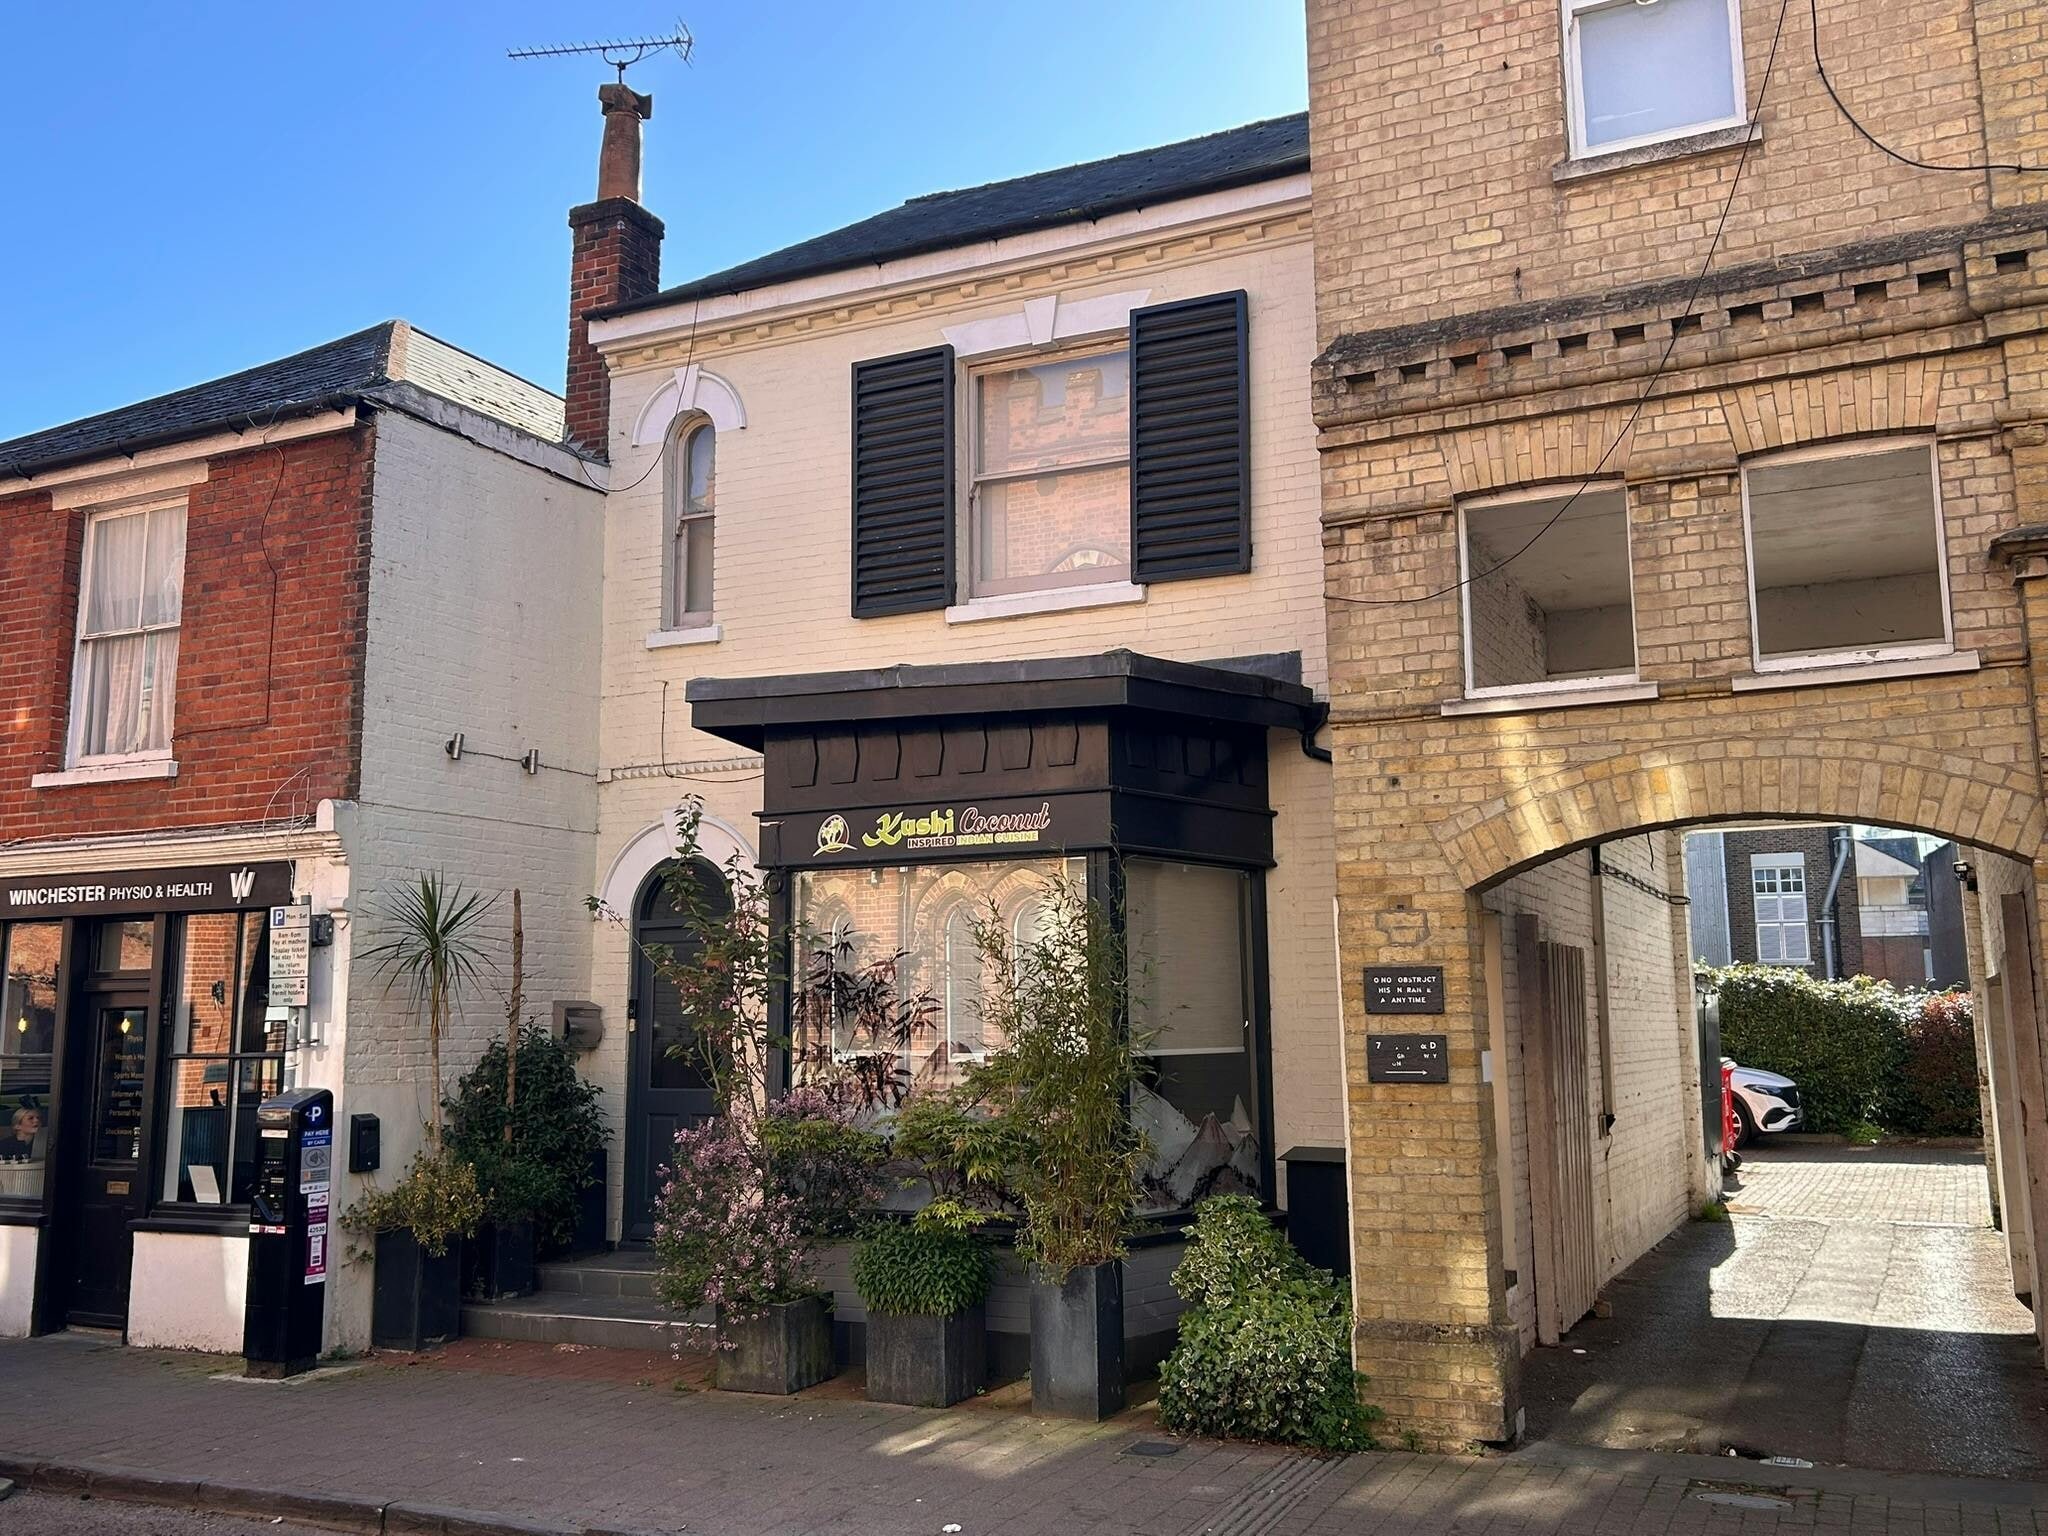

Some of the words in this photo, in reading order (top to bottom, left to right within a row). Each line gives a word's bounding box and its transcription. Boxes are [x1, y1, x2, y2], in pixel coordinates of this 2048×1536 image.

[862, 808, 955, 847] Kushi
[959, 802, 1051, 834] Coconut
[907, 836, 955, 849] INSPIRED
[956, 833, 994, 846] INDIAN
[994, 831, 1039, 844] CUISINE
[9, 885, 106, 905] WINCHESTER
[109, 886, 153, 900] PHYSIO
[155, 886, 164, 898] &
[166, 882, 213, 897] HEALTH
[275, 910, 284, 925] P
[299, 912, 308, 920] Sat
[1391, 996, 1407, 1004] ANY
[1407, 996, 1427, 1004] TIME
